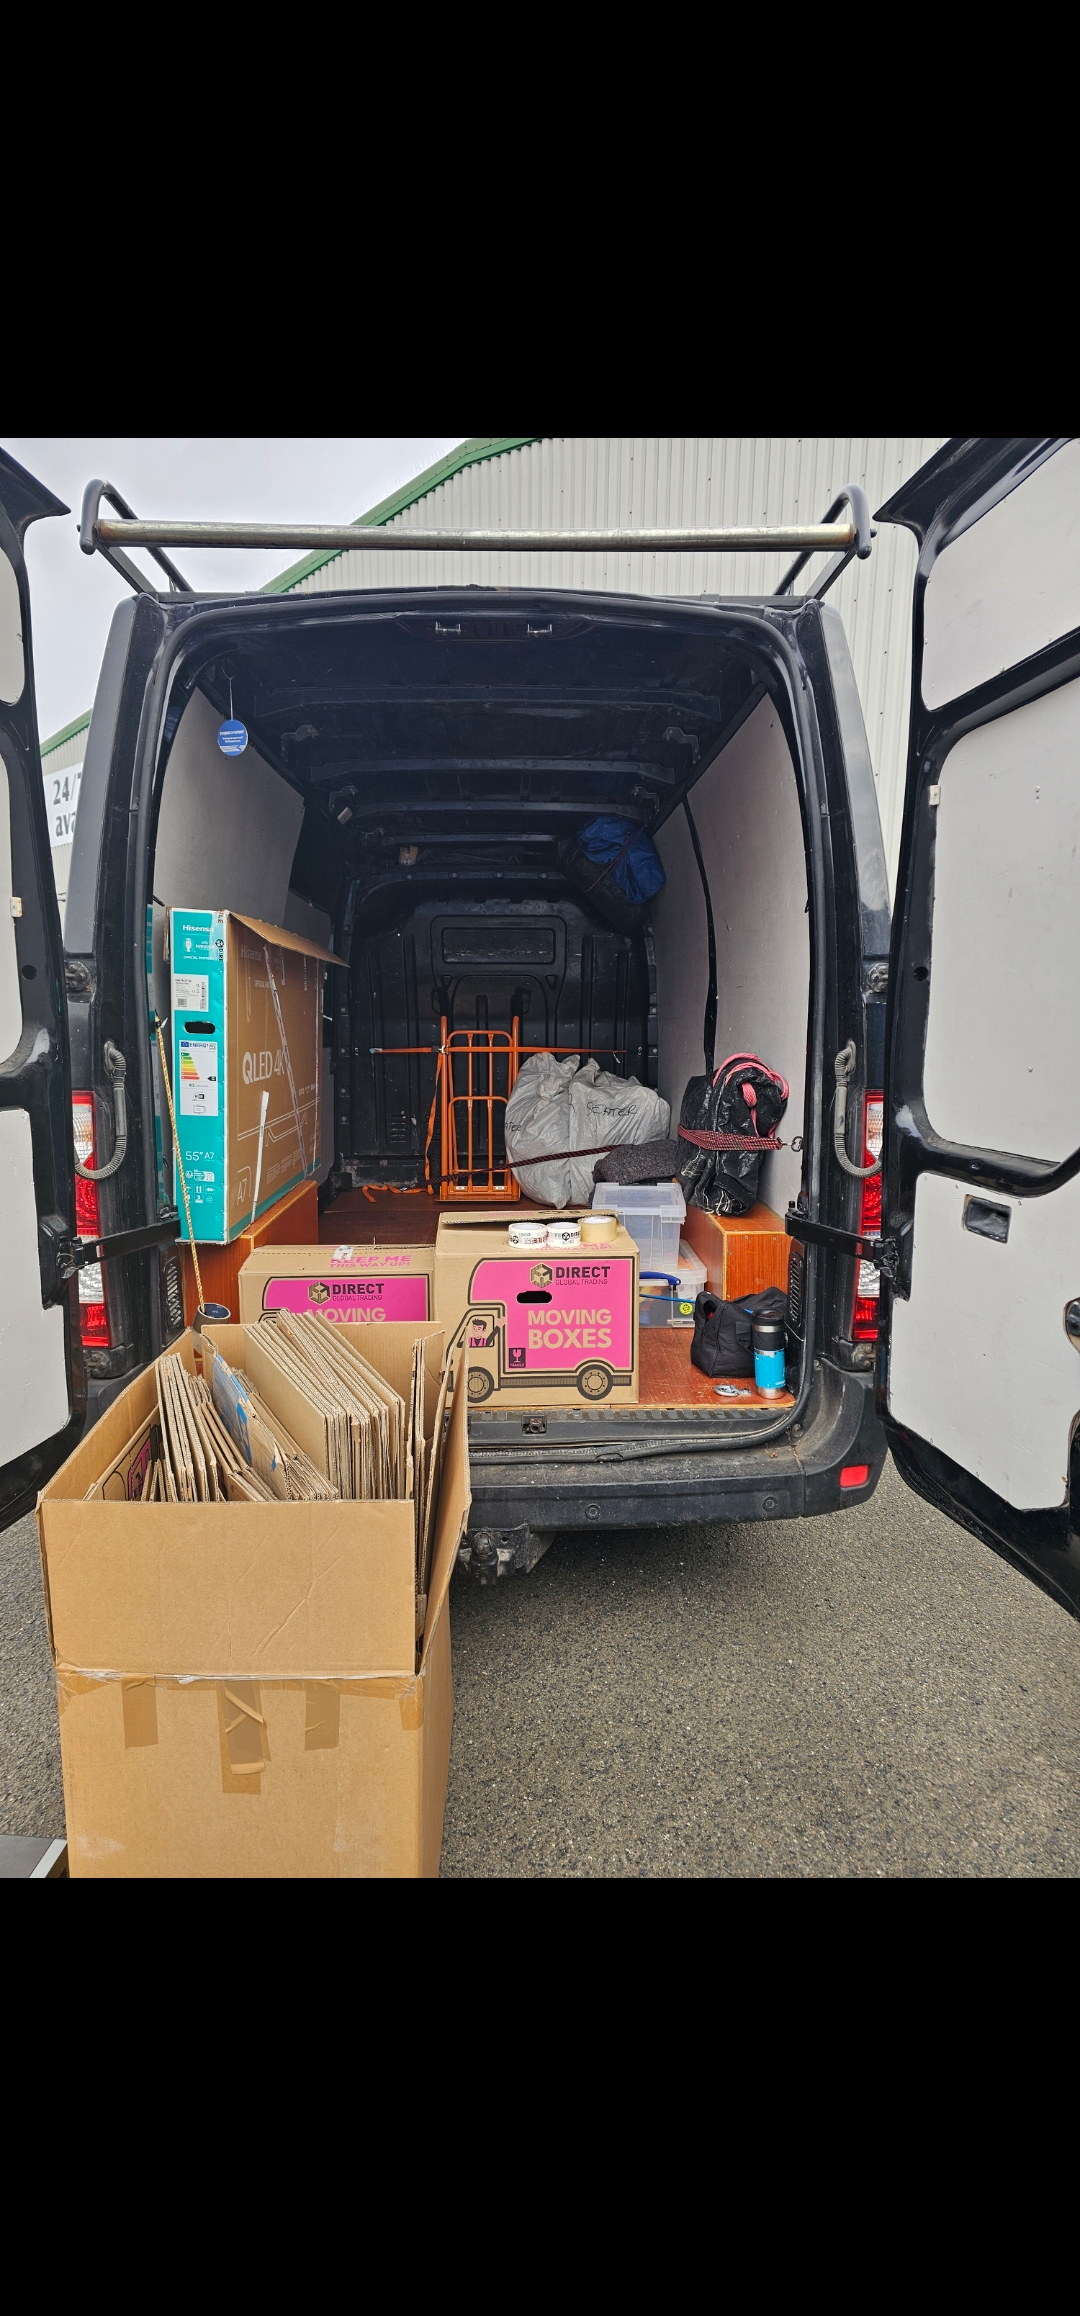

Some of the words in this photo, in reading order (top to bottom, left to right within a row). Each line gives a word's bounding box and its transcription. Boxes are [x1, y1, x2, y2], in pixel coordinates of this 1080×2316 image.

[182, 924, 215, 933] Hisense
[242, 1051, 273, 1085] QLED
[204, 1151, 215, 1160] A7
[385, 1255, 412, 1263] ME
[556, 1266, 611, 1279] DIRECT
[332, 1283, 385, 1295] DIRECT
[527, 1308, 613, 1326] MOVING
[528, 1327, 613, 1350] BOXES
